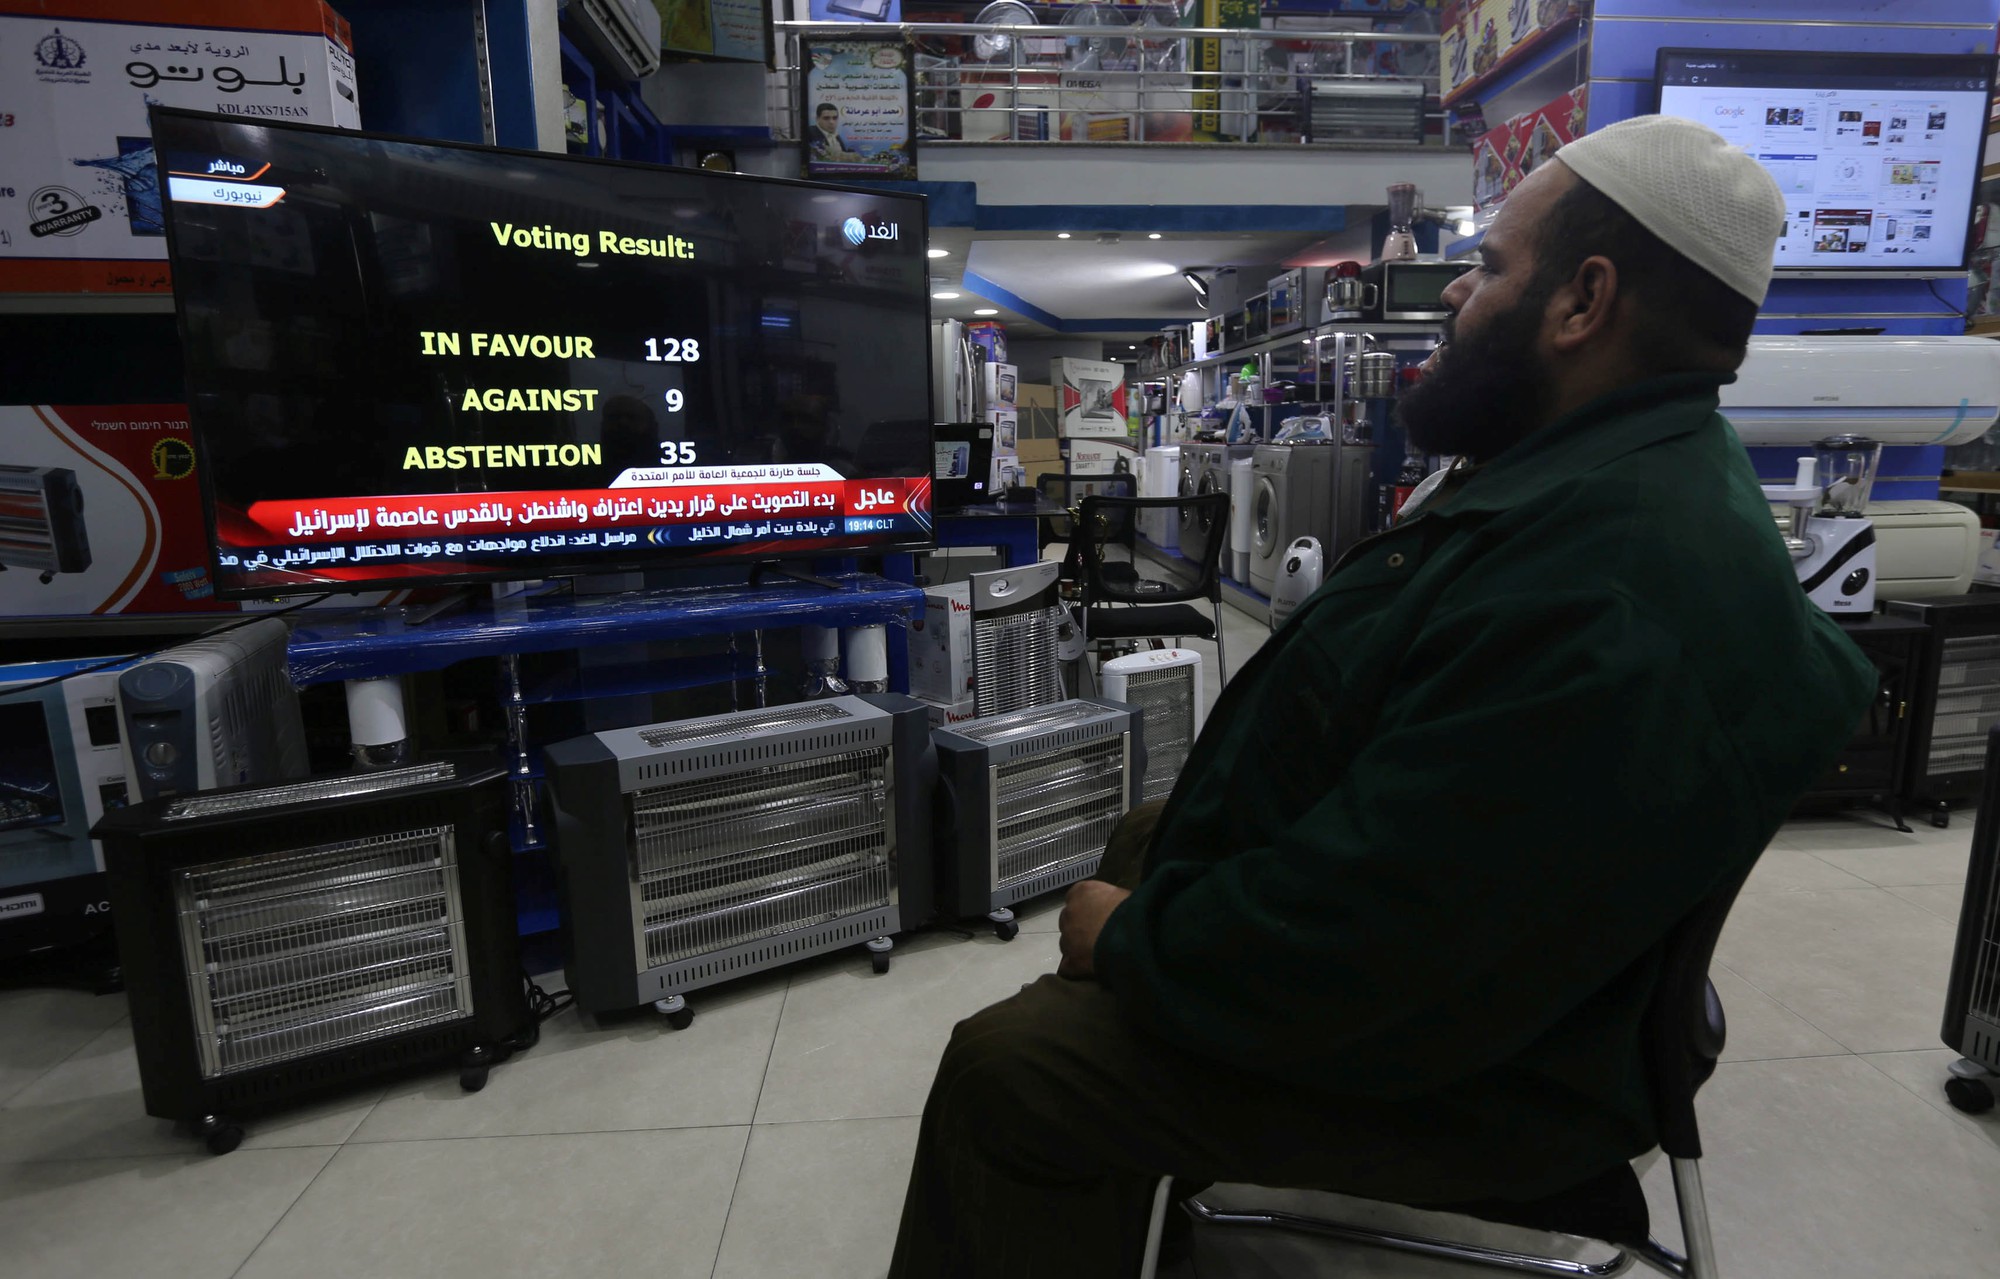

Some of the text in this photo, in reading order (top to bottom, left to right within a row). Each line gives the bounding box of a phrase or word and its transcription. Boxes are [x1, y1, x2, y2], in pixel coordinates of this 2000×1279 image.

[216, 103, 309, 117] KDL42XS715AN
[1714, 105, 1744, 118] Google
[208, 160, 246, 176] مباشر
[213, 186, 262, 203] نيويورك
[41, 192, 69, 214] 3
[36, 209, 93, 234] WARRANTY
[868, 220, 899, 242] الغد
[490, 221, 696, 259] Voting Result:
[420, 332, 700, 362] IN FAVOUR 128
[461, 388, 684, 412] AGAINST 9
[403, 442, 697, 470] ABSTENTION 35
[631, 470, 669, 482] المتحدة
[672, 470, 696, 482] للأمم
[699, 469, 728, 480] العامة
[730, 468, 766, 482] للجمعية
[797, 467, 822, 479] جلسة
[853, 488, 895, 511] عاجل
[288, 490, 836, 538] بدء التصويت على قرار يدين اعتراف واشنطن بالقدس عاصمة لإسرائيل
[688, 520, 836, 542] في بلدة بيت أمر شمال الخليل
[848, 518, 895, 532] 19:14 CLT
[466, 538, 528, 553] مواجهات
[531, 536, 566, 552] اندلاع
[568, 530, 597, 546] الغد:
[600, 532, 638, 547] مراسل
[350, 544, 400, 562] الاحتلال
[404, 541, 442, 556] قوات
[444, 542, 465, 556] مع
[244, 550, 268, 571] في
[272, 547, 346, 570] الإسرائيلي
[84, 900, 111, 915] AC
